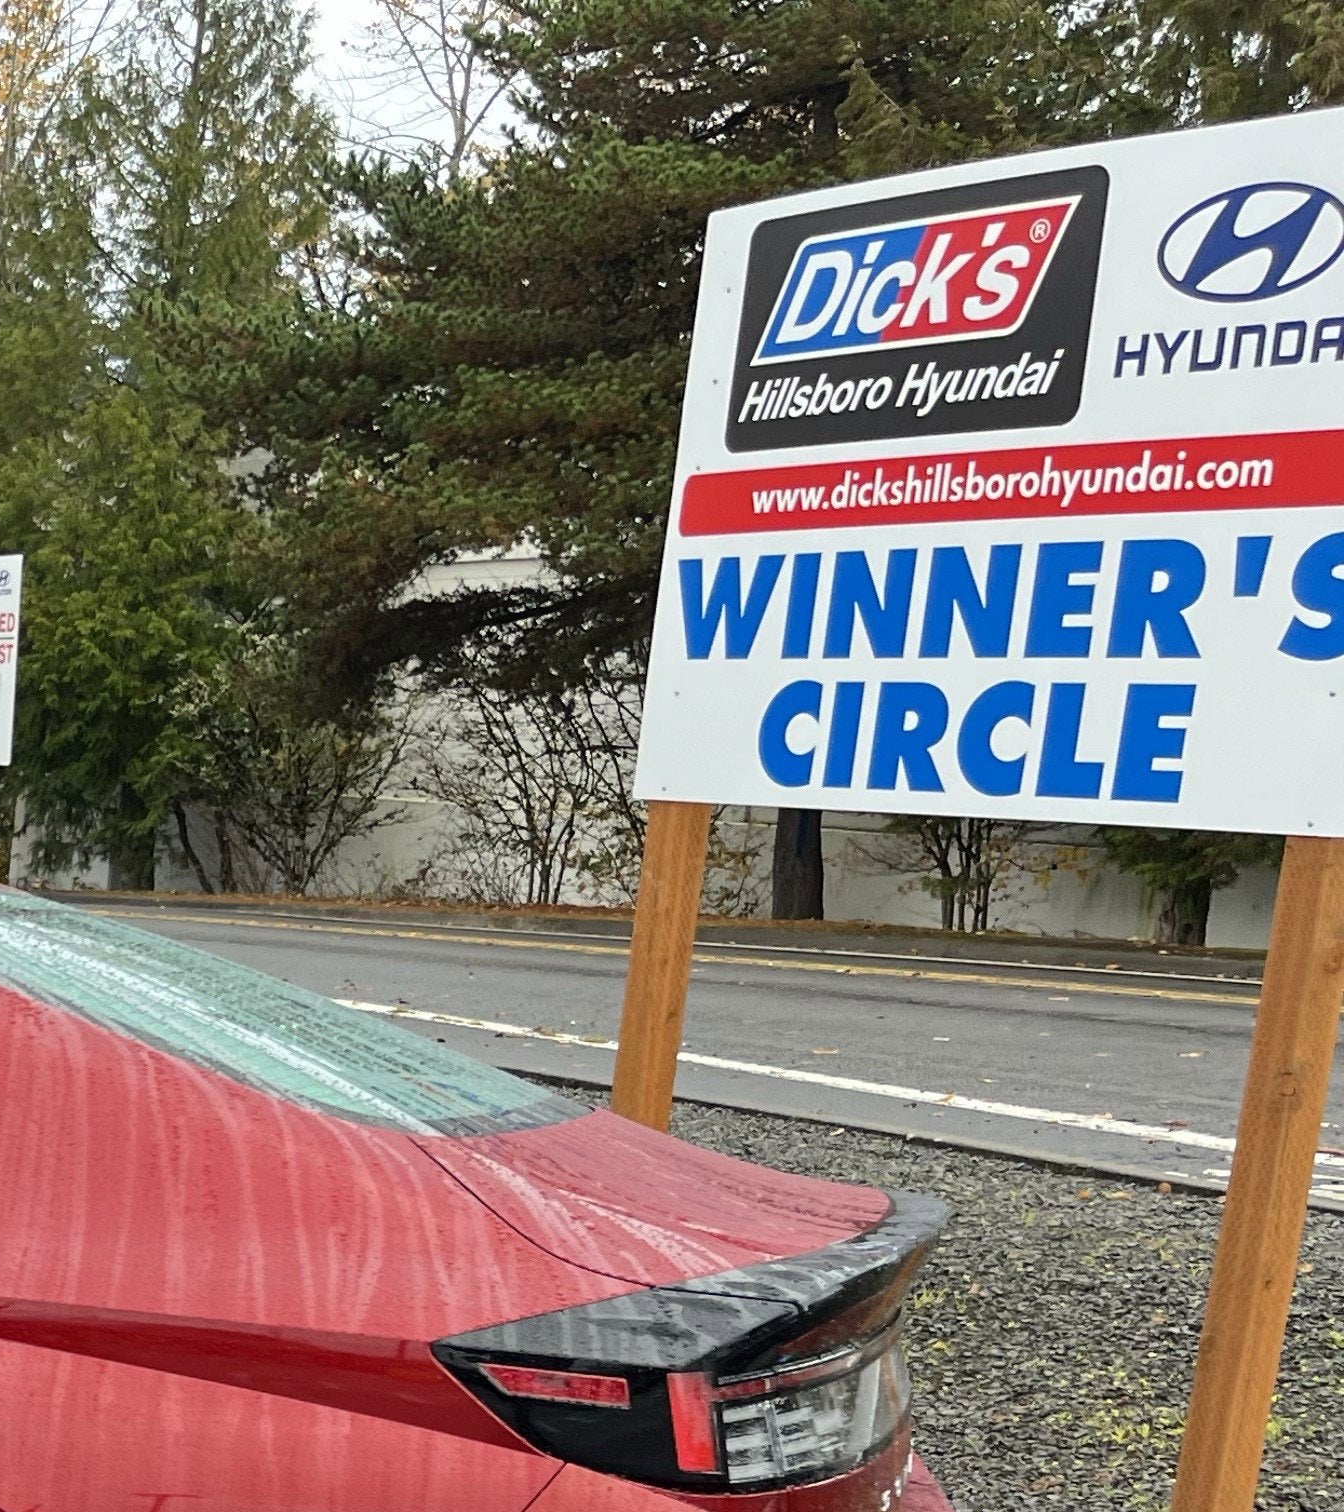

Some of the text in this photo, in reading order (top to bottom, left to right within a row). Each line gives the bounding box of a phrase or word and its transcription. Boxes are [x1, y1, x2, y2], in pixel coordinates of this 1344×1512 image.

[775, 221, 1031, 345] Dick's
[737, 348, 1066, 424] Hillsboro Hyundai
[751, 451, 1274, 515] www.dickshillsborohyundai.com
[677, 531, 1344, 661] WINNER'S
[758, 679, 1198, 803] CIRCLE
